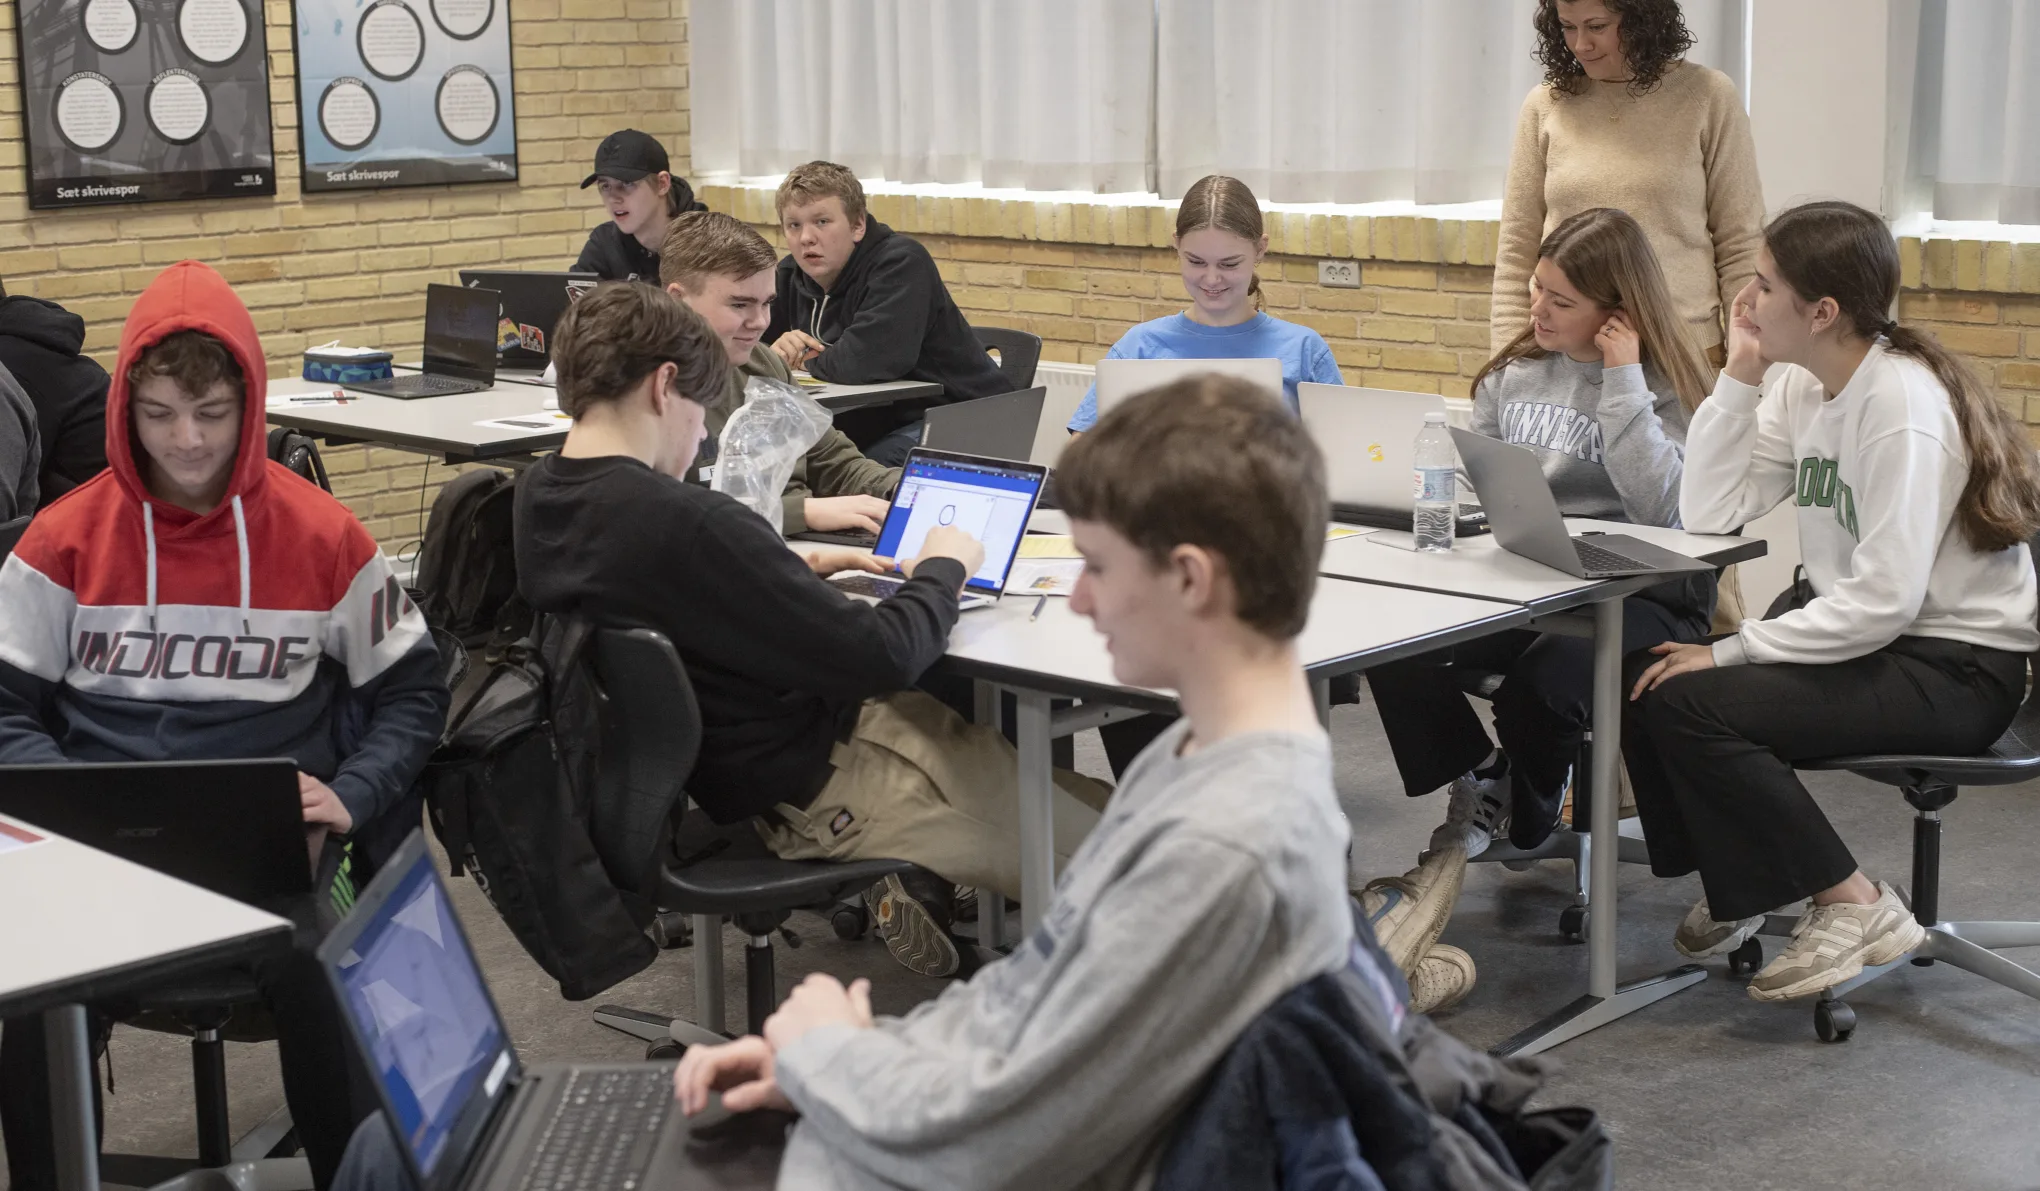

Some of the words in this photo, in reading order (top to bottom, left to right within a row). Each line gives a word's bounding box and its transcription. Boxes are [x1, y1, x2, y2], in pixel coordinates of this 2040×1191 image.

[62, 71, 111, 87] KONSTATERENDE
[152, 68, 200, 84] REFLEKTERENDE
[326, 172, 347, 182] Sæt
[349, 170, 400, 181] skrivespor
[56, 188, 80, 198] Sæt
[82, 184, 140, 197] skrivespor
[77, 631, 309, 679] INDICODE
